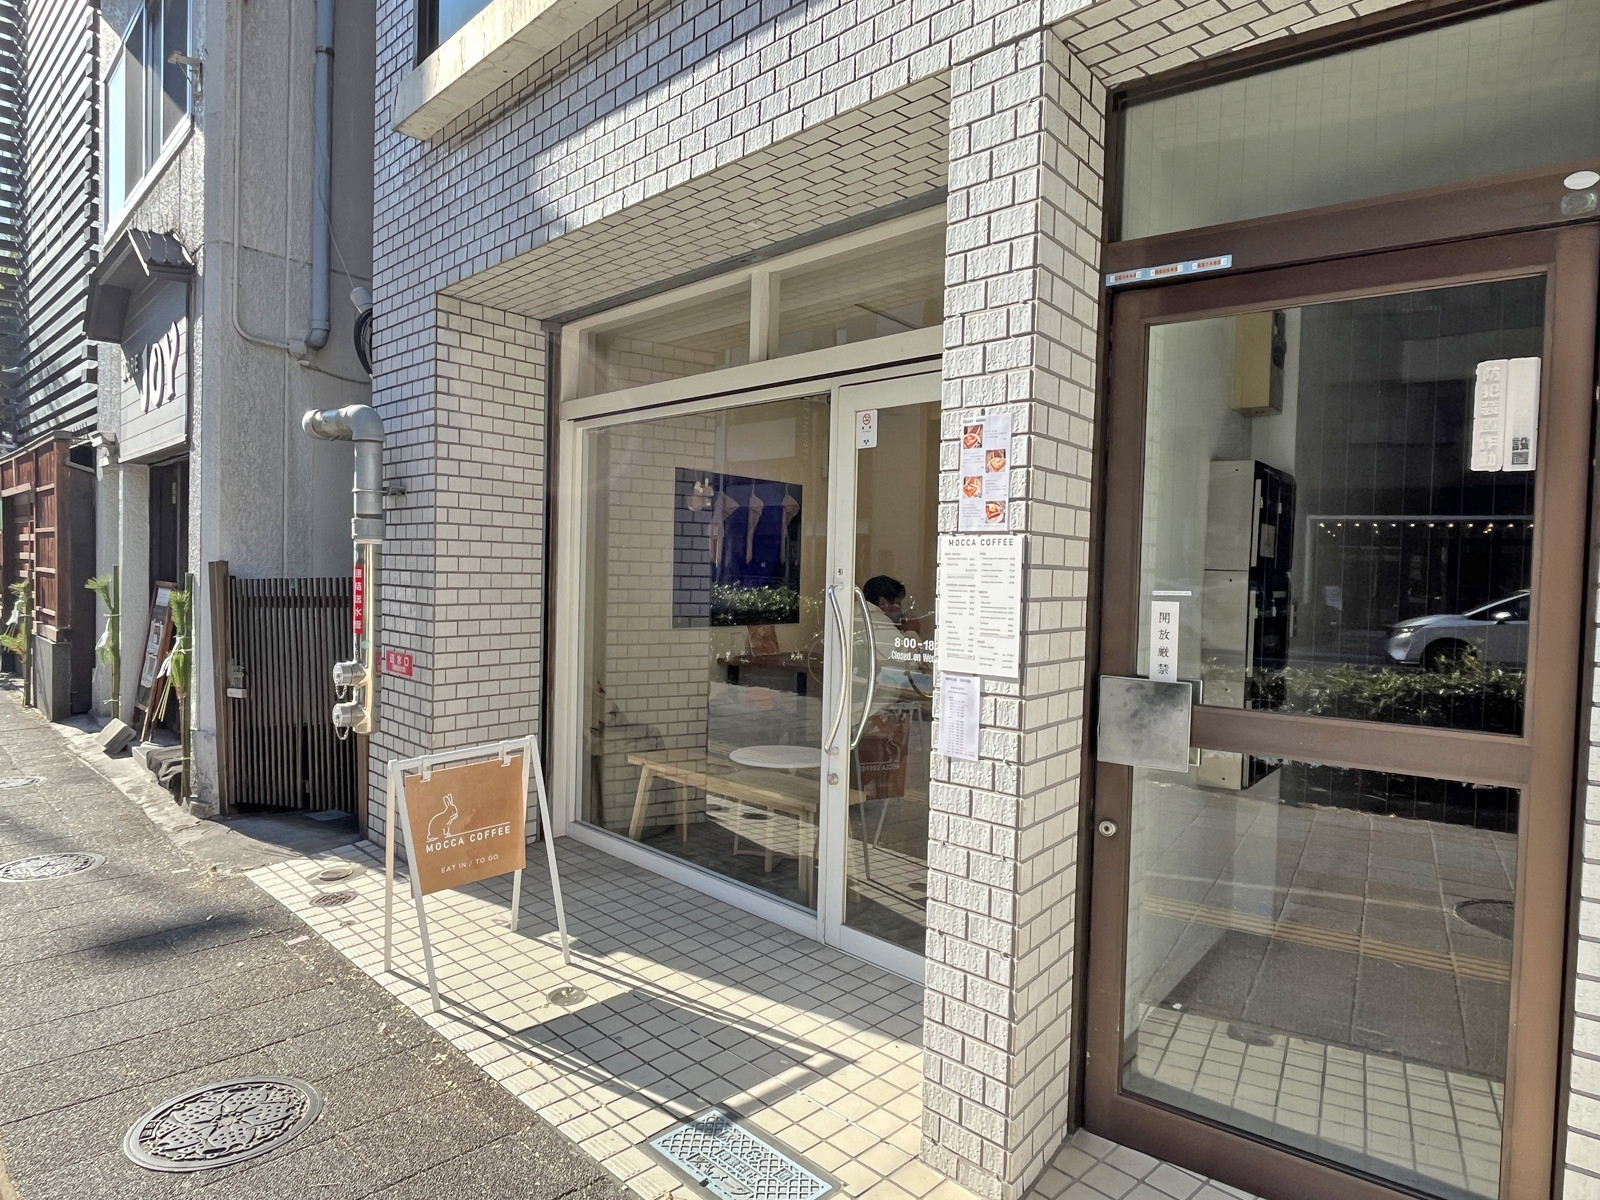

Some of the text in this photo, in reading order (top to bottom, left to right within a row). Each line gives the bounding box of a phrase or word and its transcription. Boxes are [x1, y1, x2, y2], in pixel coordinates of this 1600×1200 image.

[140, 322, 180, 413] JOY
[948, 538, 1014, 547] MOCCA COFFEE
[1158, 611, 1171, 675] 開放厳禁
[891, 650, 911, 661] Closed
[912, 653, 921, 662] on
[426, 825, 511, 853] MOCCA COFFEE
[440, 864, 456, 874] EAT
[475, 857, 486, 865] TO
[488, 853, 499, 862] GO
